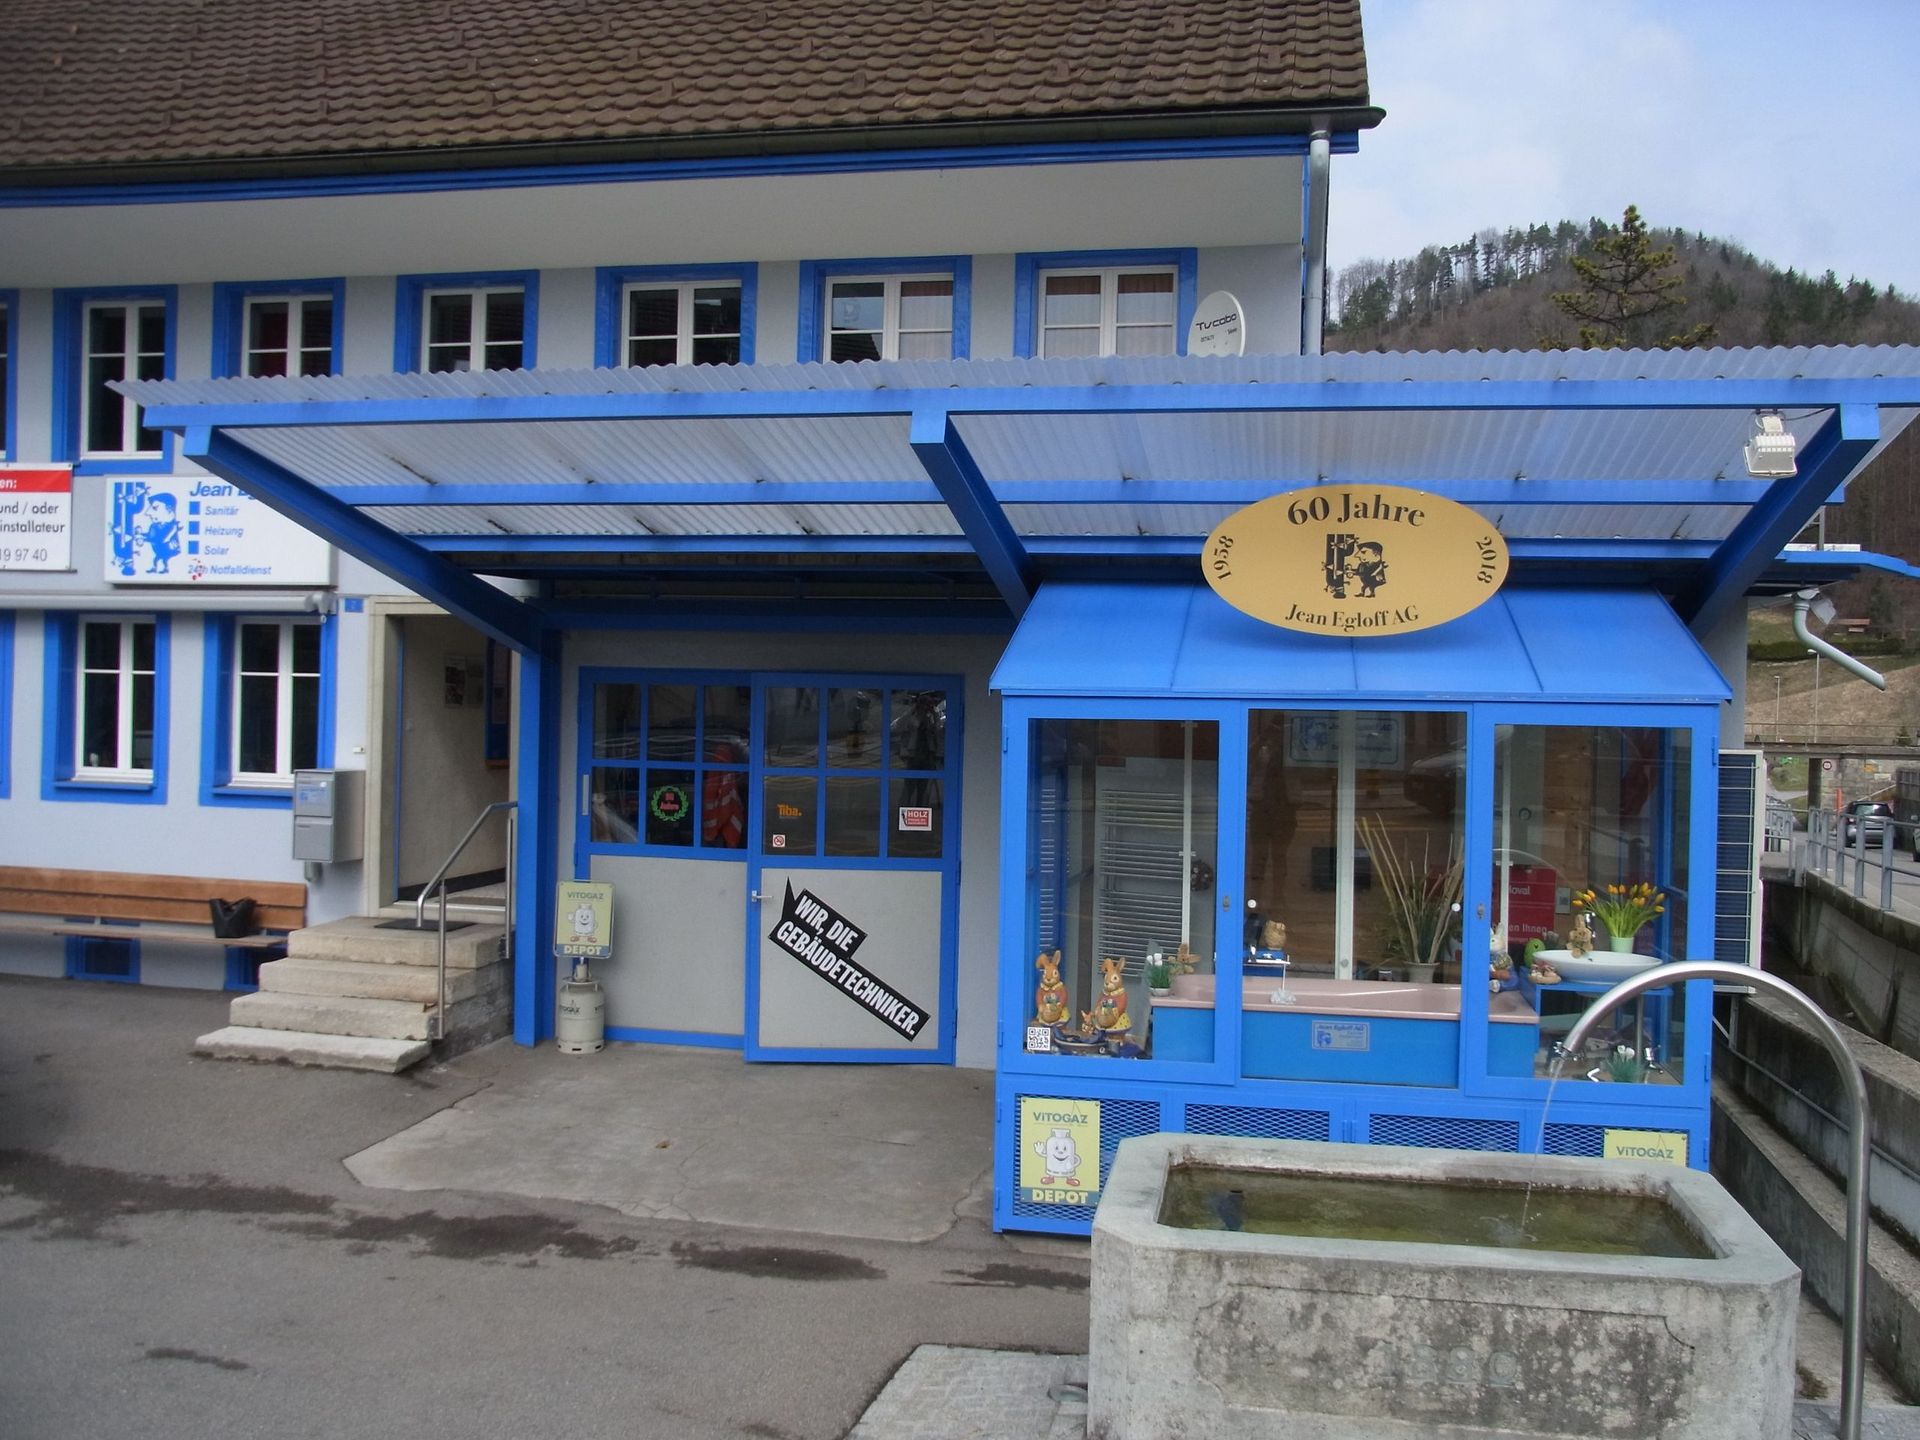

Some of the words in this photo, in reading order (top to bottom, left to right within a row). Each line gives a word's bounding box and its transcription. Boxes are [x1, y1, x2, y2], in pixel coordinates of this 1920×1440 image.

[190, 481, 233, 497] Jean
[31, 501, 59, 514] oder
[205, 505, 239, 516] Sanitär
[1287, 496, 1330, 525] 60
[1337, 493, 1425, 527] Jahre
[204, 526, 244, 538] Heizung
[15, 548, 29, 561] 97
[32, 548, 48, 561] 40
[204, 545, 230, 556] Solar
[1213, 535, 1234, 579] 1958
[1475, 536, 1497, 584] 2018
[1285, 604, 1328, 626] Jean
[1332, 610, 1389, 633] Egloff
[1392, 604, 1419, 625] AG
[907, 810, 928, 818] HOLZ
[794, 895, 829, 936] WIR,
[825, 919, 859, 952] DIE
[563, 945, 602, 956] DEPOT
[776, 920, 920, 1036] GEBÄUDETECHNIKER.
[1033, 1111, 1088, 1124] VITOGAZ
[1616, 1146, 1674, 1159] VITOGAZ
[1032, 1189, 1088, 1204] DEPOT
